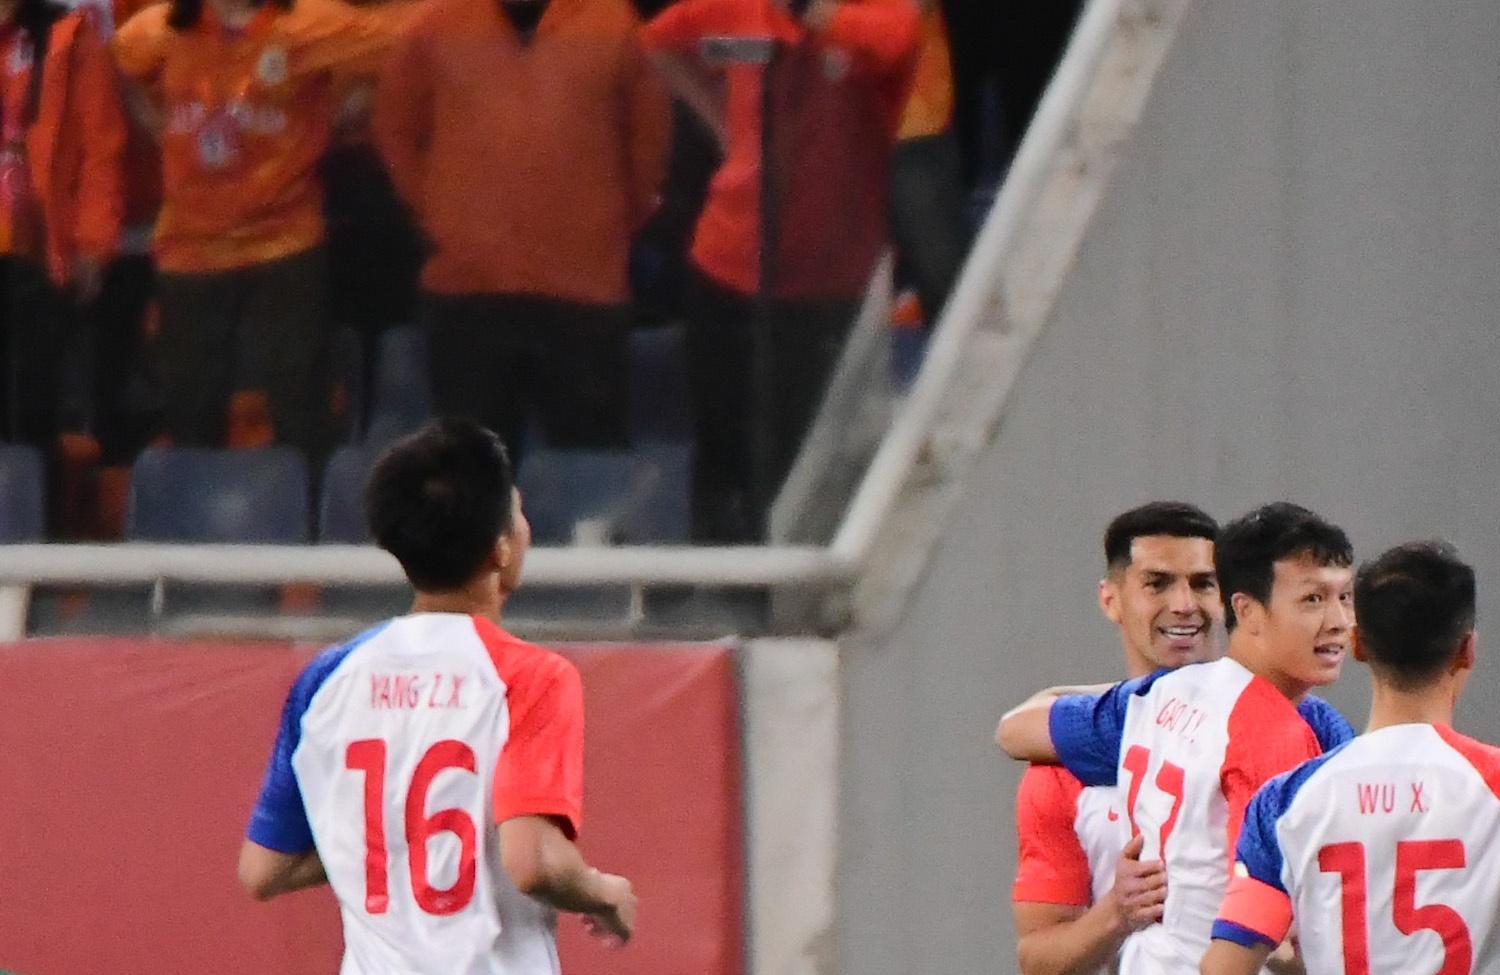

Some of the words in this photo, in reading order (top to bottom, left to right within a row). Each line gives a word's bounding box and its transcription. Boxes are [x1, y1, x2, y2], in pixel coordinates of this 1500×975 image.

[370, 673, 420, 710] YANG
[1357, 782, 1396, 815] WU
[1410, 780, 1430, 814] X.
[345, 737, 477, 917] 16
